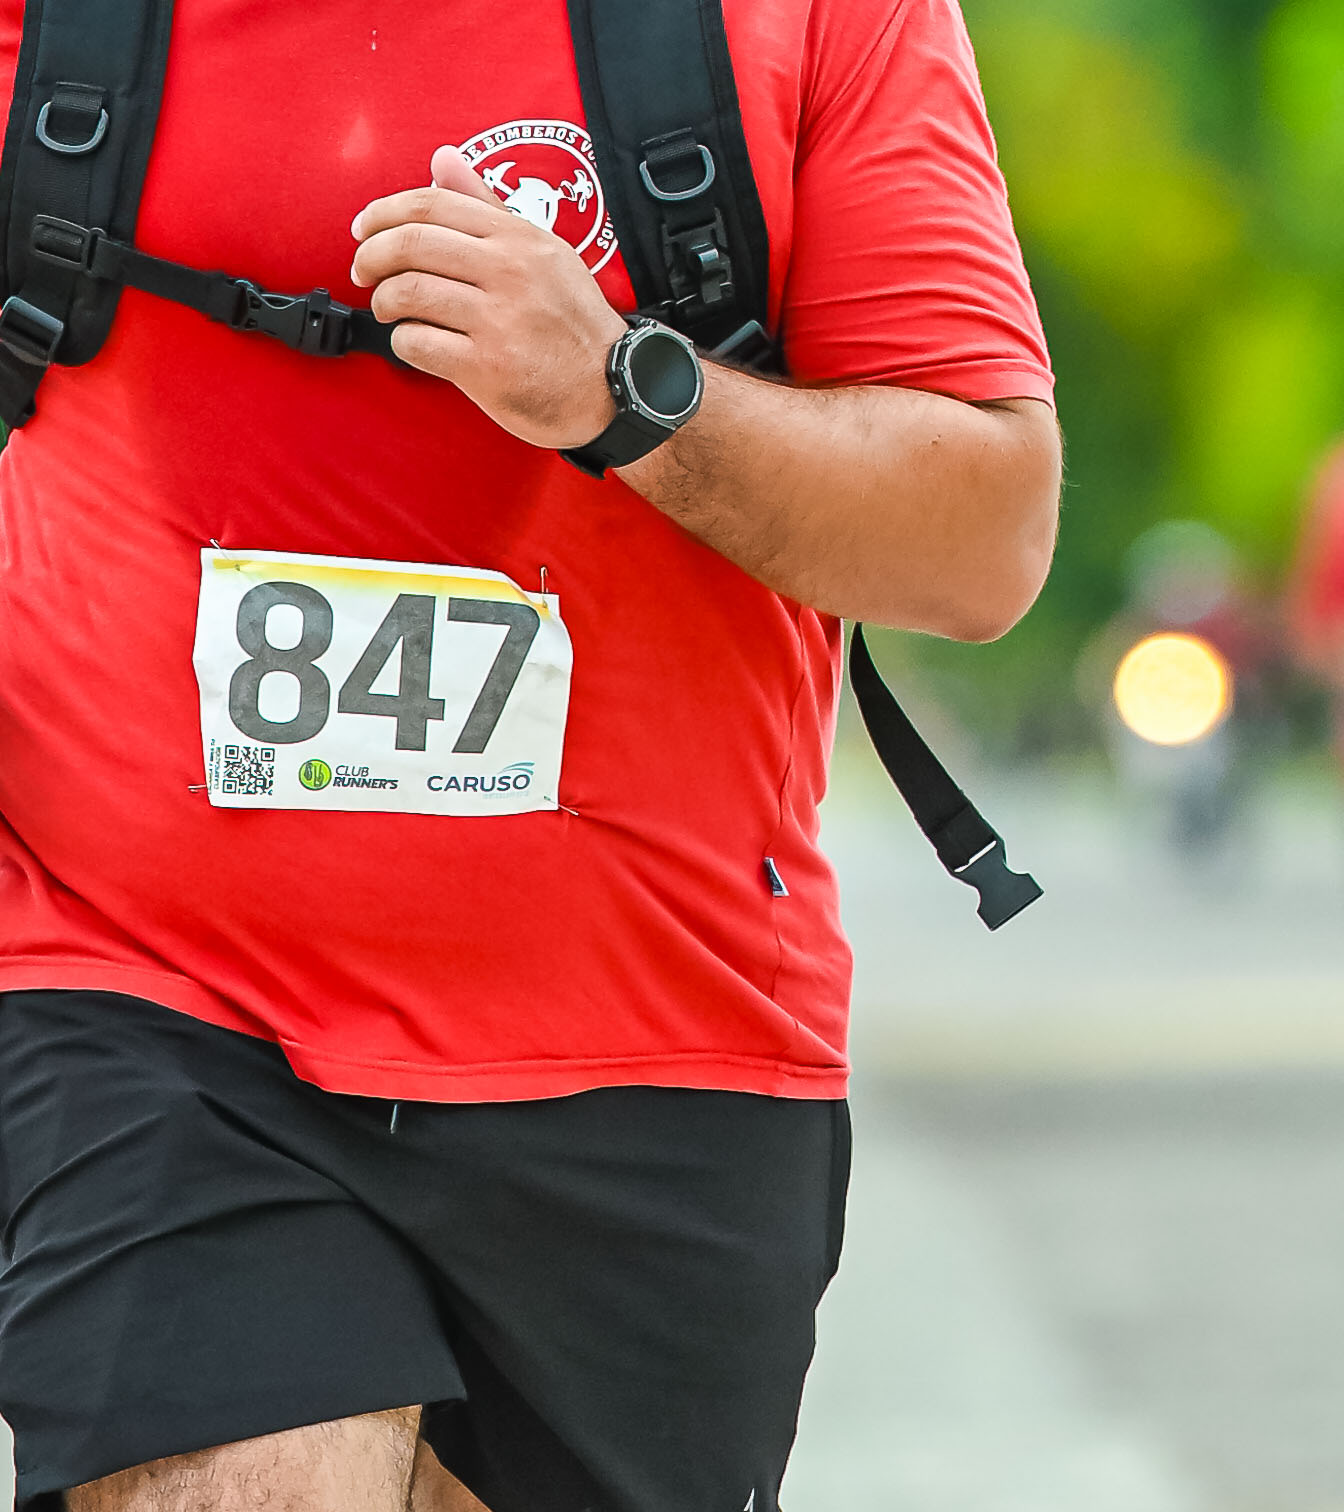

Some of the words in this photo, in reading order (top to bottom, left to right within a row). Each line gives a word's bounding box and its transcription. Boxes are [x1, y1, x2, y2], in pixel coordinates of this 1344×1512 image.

[482, 126, 579, 151] BOMBEROS
[228, 581, 541, 753] 847
[335, 765, 369, 777] CLUB
[332, 776, 398, 790] RUNNER'S
[427, 773, 531, 792] CARUSO
